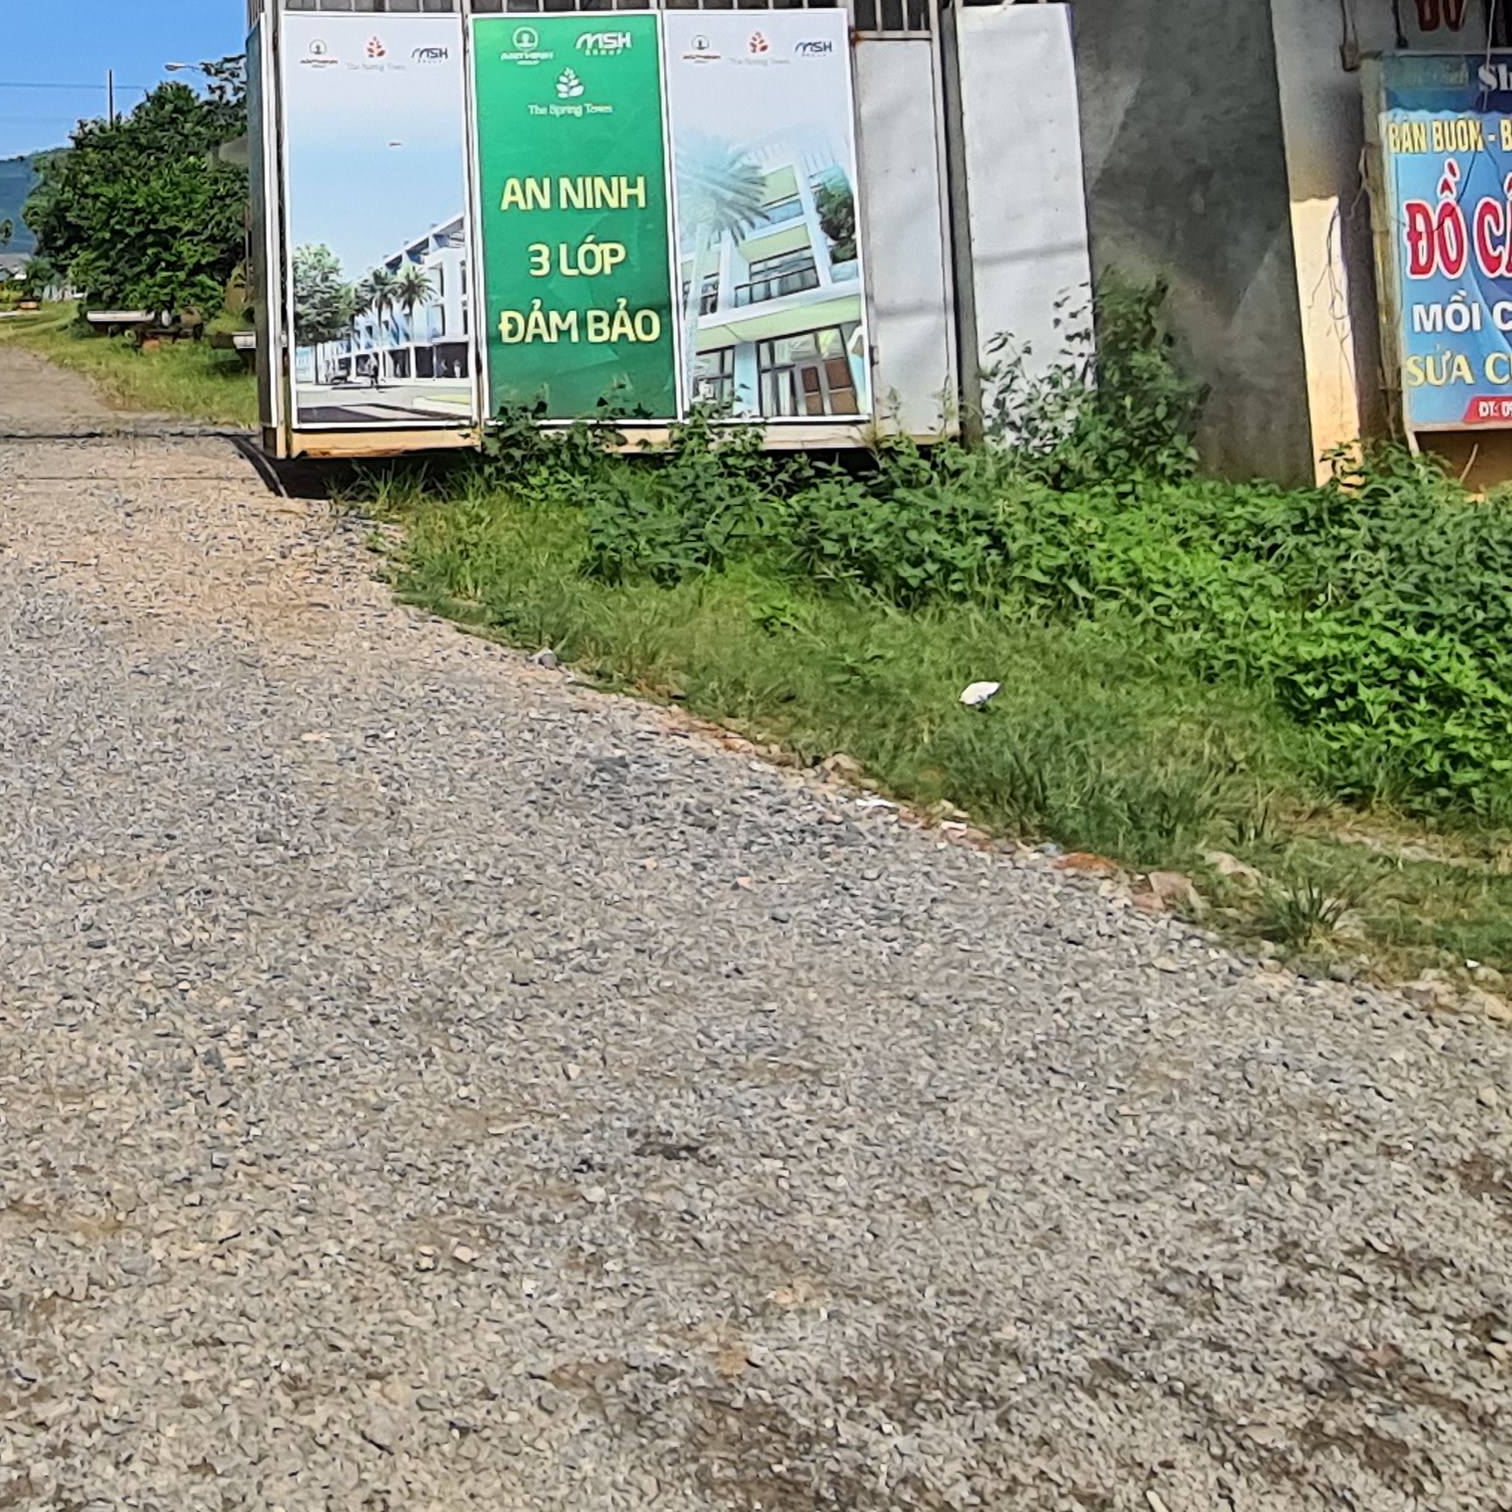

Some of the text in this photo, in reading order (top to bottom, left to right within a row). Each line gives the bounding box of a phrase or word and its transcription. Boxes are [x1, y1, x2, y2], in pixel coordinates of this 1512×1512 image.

[500, 175, 646, 211] AN NINH
[1404, 158, 1467, 278] ĐỒ
[527, 234, 626, 276] 3 LỚP
[498, 297, 661, 344] ĐẢM BẢO
[1412, 289, 1482, 333] MỒI
